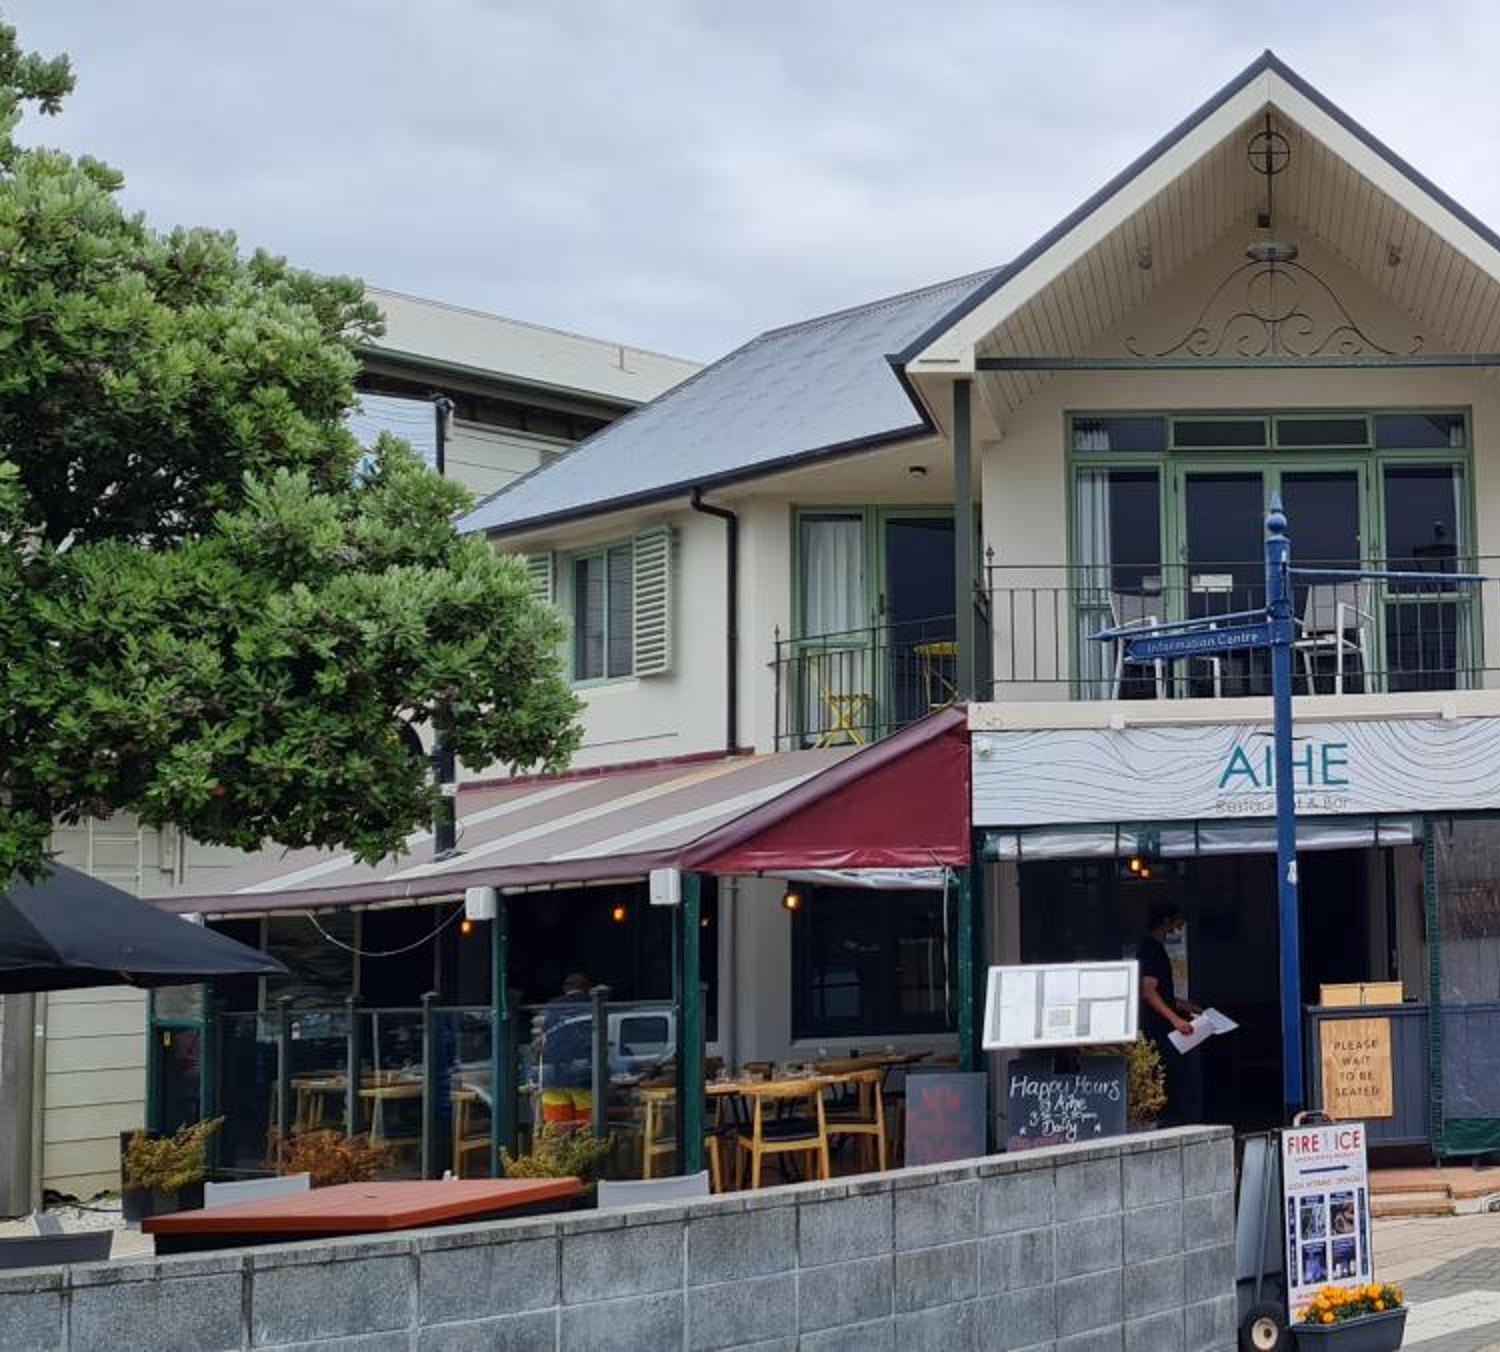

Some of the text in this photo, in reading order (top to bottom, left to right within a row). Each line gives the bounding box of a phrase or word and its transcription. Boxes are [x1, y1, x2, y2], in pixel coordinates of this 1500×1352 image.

[1147, 632, 1258, 653] Information Centre
[1333, 1039, 1377, 1051] PLEASE
[1342, 1055, 1370, 1067] WAIT
[1340, 1071, 1375, 1081] TO BE
[1009, 1075, 1120, 1101] Happy Hours
[1335, 1085, 1381, 1097] SEATED
[1041, 1119, 1077, 1142] Daily
[1287, 1130, 1361, 1154] FIRE ICE
